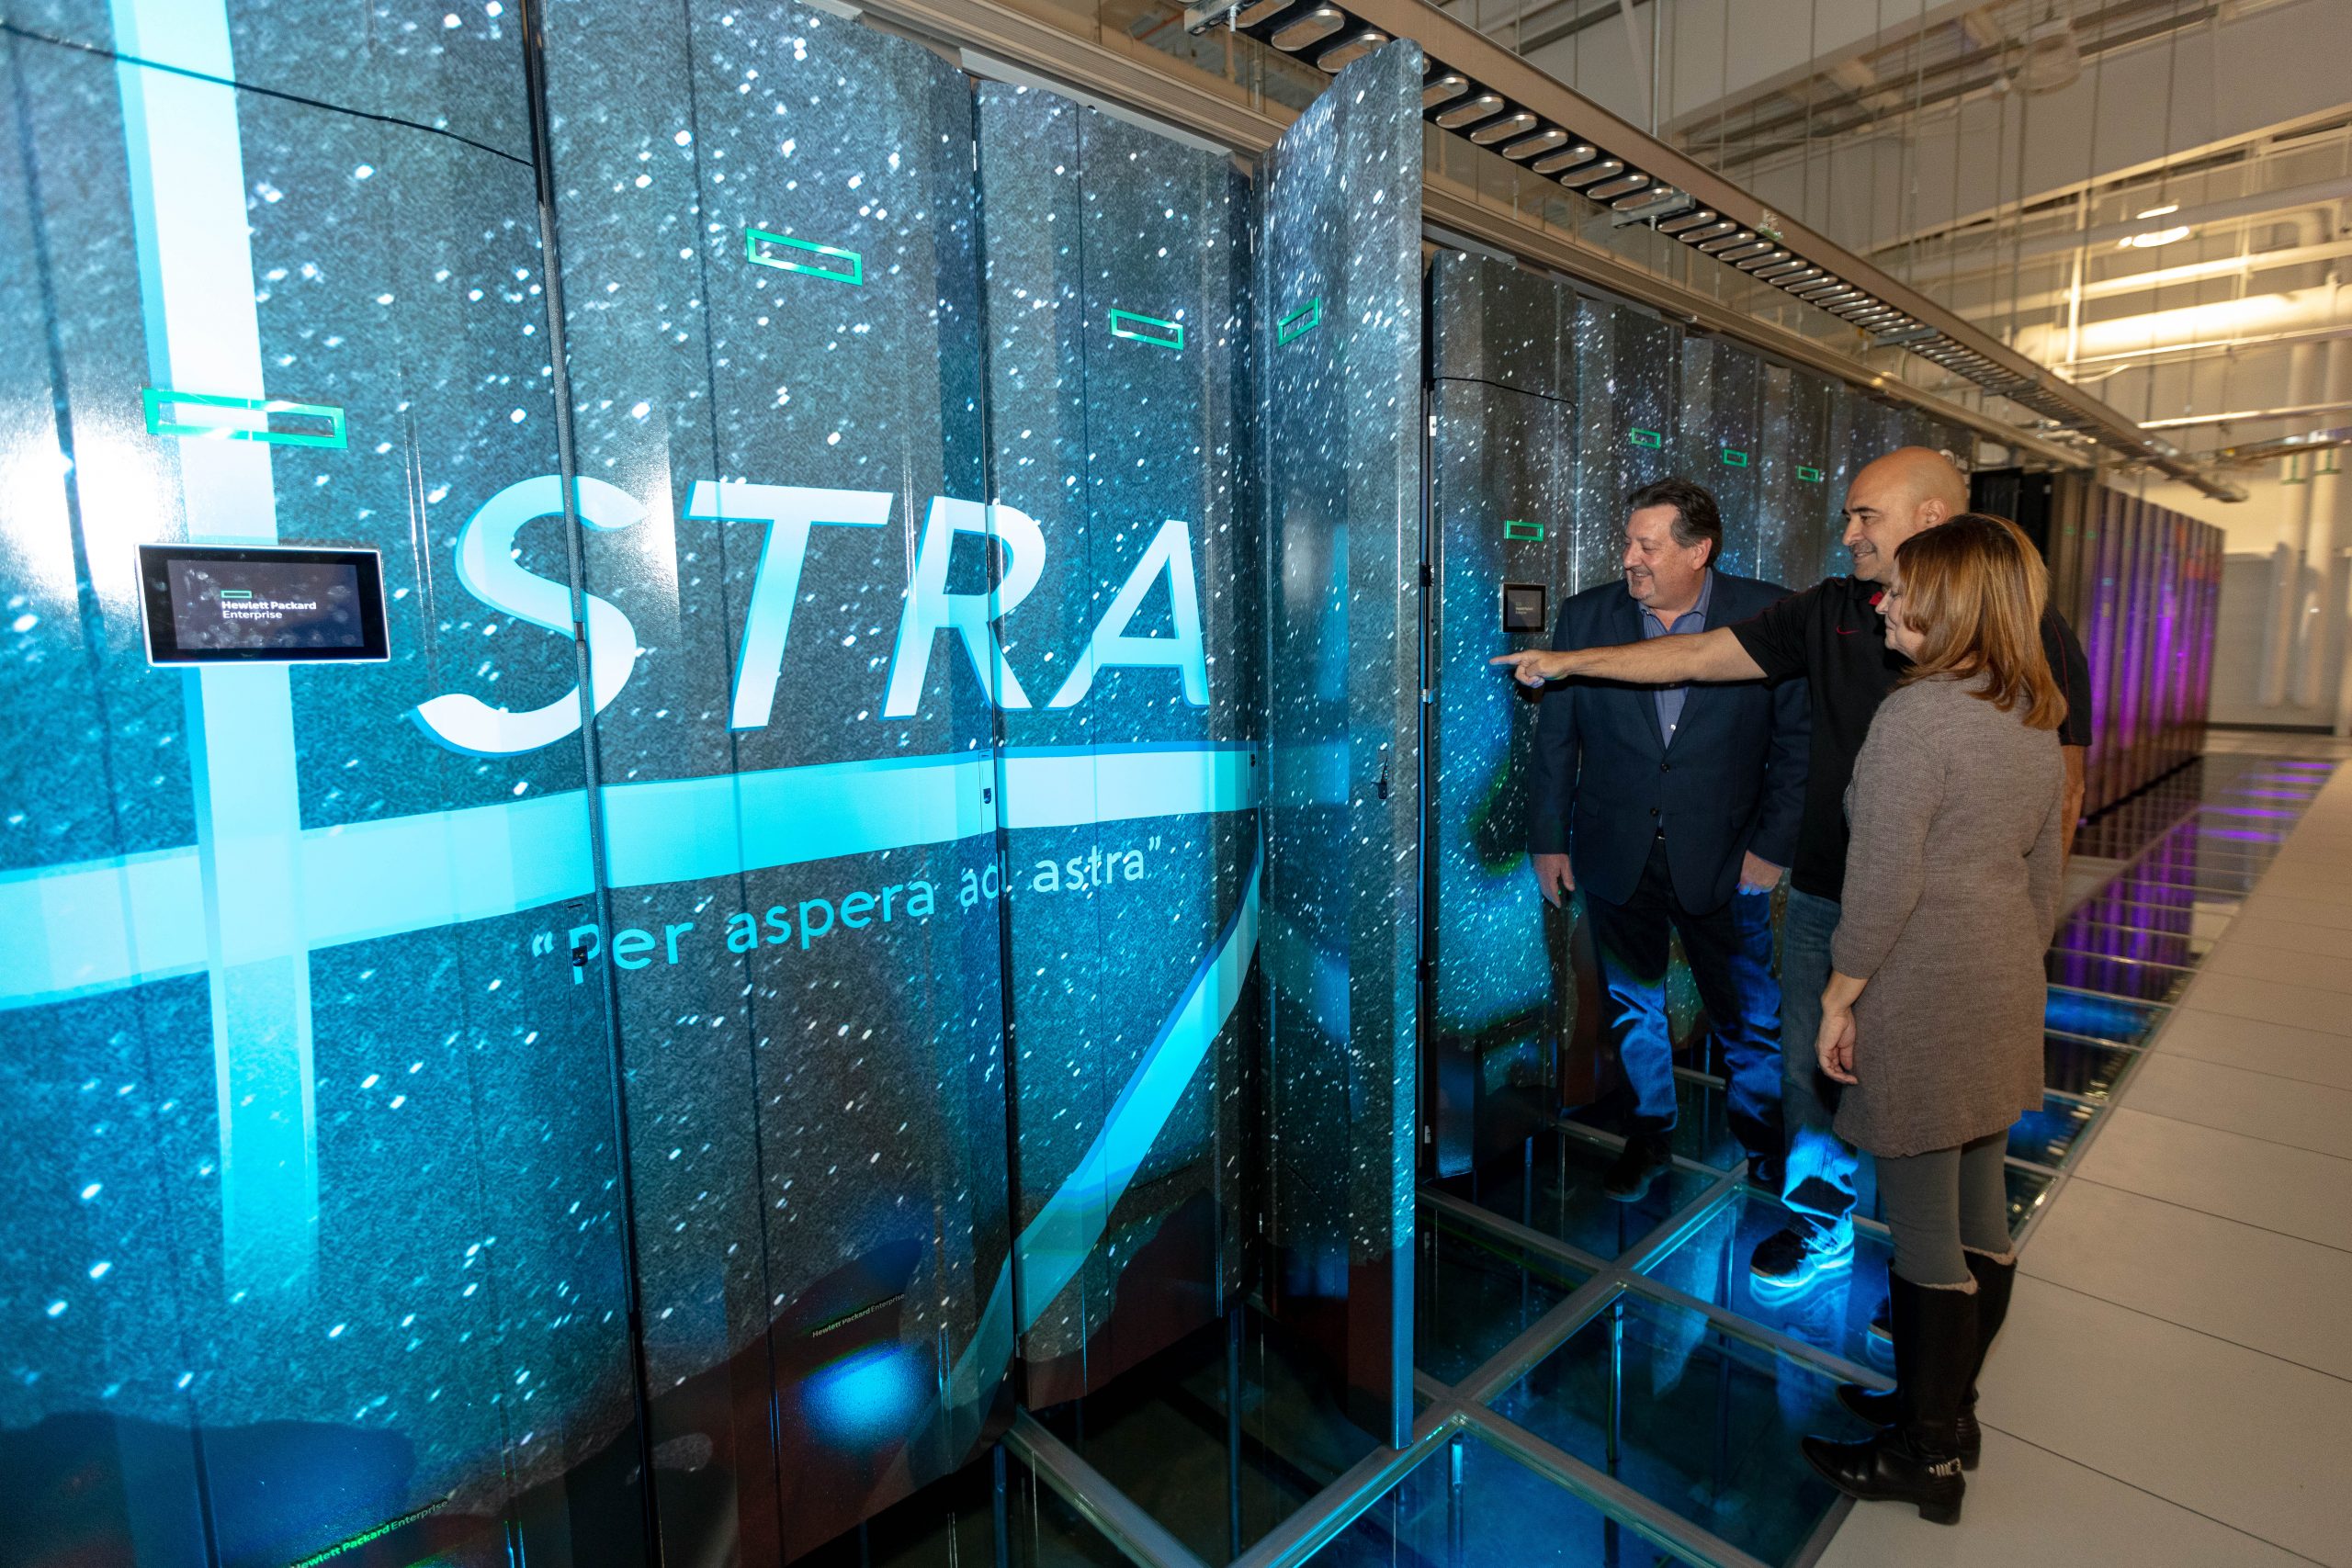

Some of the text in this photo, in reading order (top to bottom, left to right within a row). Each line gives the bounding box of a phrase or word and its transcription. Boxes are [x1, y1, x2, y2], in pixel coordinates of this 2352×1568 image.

[221, 601, 317, 611] Hewlett Packard
[222, 610, 283, 620] Enterprise
[726, 878, 935, 953] aspera
[812, 1292, 905, 1338] Hewlett Packard Enterprise
[342, 1524, 390, 1552] Packard
[390, 1500, 448, 1531] Enterprise
